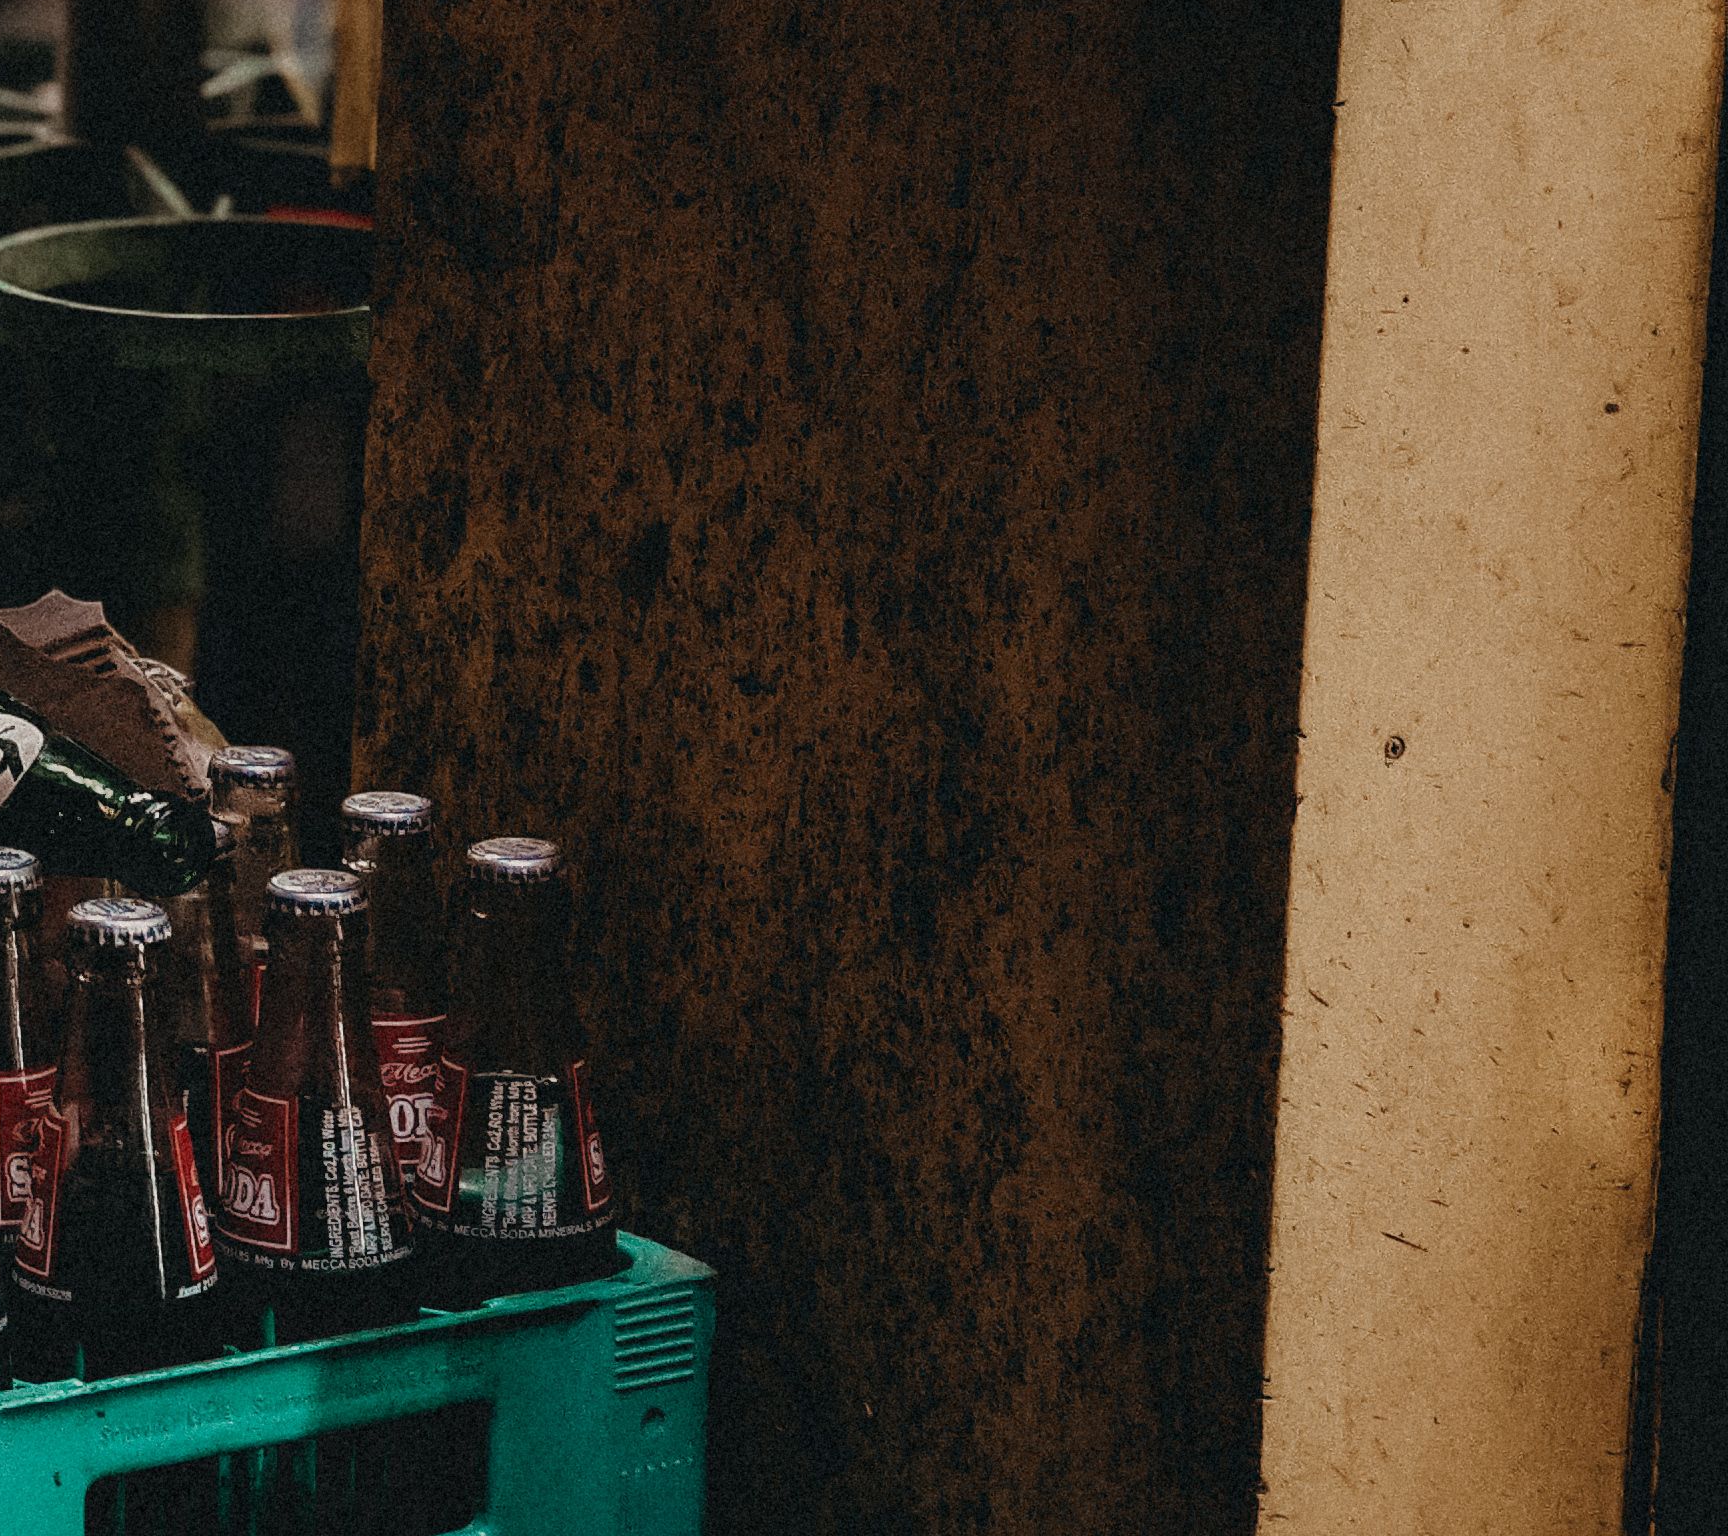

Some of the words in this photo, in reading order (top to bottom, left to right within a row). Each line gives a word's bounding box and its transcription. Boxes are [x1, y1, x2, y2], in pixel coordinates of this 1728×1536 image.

[453, 1223, 497, 1239] MECCA
[498, 1225, 536, 1241] SODA
[300, 1257, 347, 1272] MECCA
